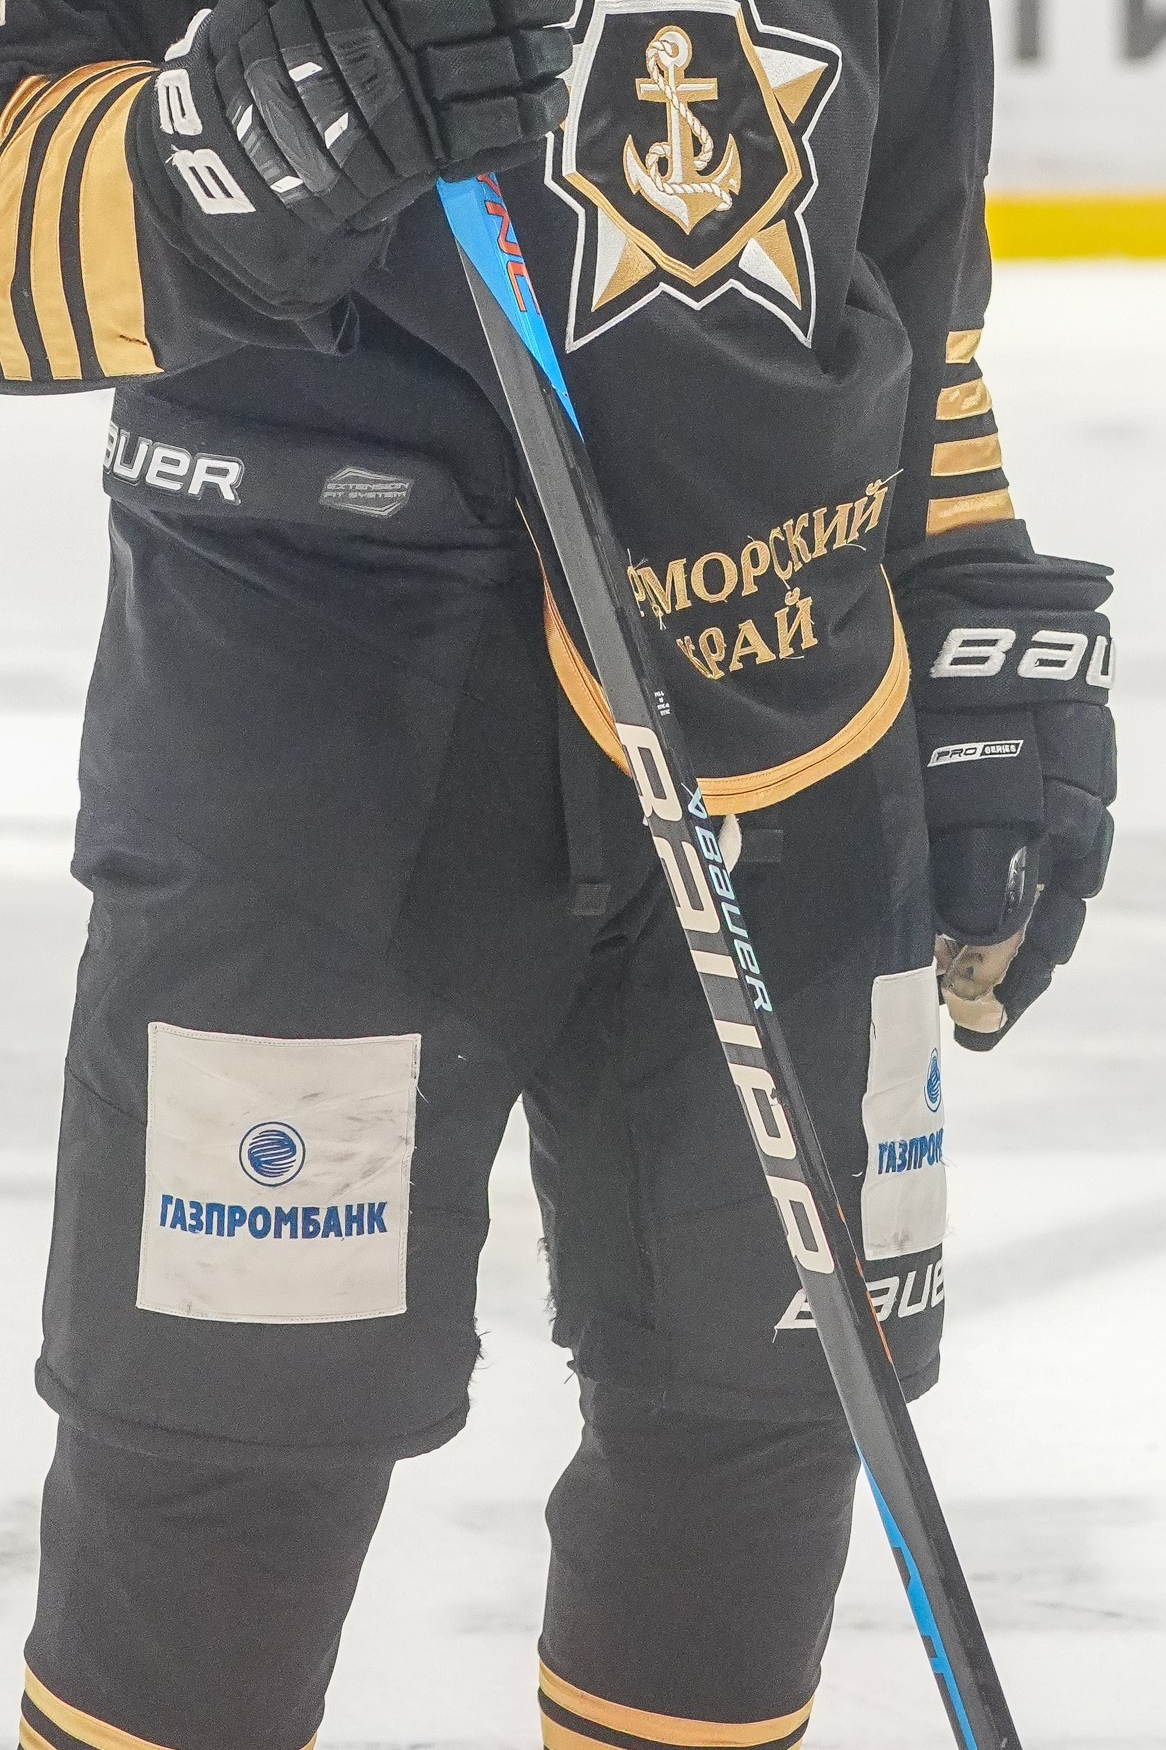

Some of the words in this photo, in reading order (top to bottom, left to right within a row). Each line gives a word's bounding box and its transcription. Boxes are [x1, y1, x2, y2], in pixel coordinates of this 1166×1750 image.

[935, 744, 977, 762] PRO
[697, 824, 773, 1013] BAUER
[159, 1194, 388, 1240] ГАЗПРОМБАНК
